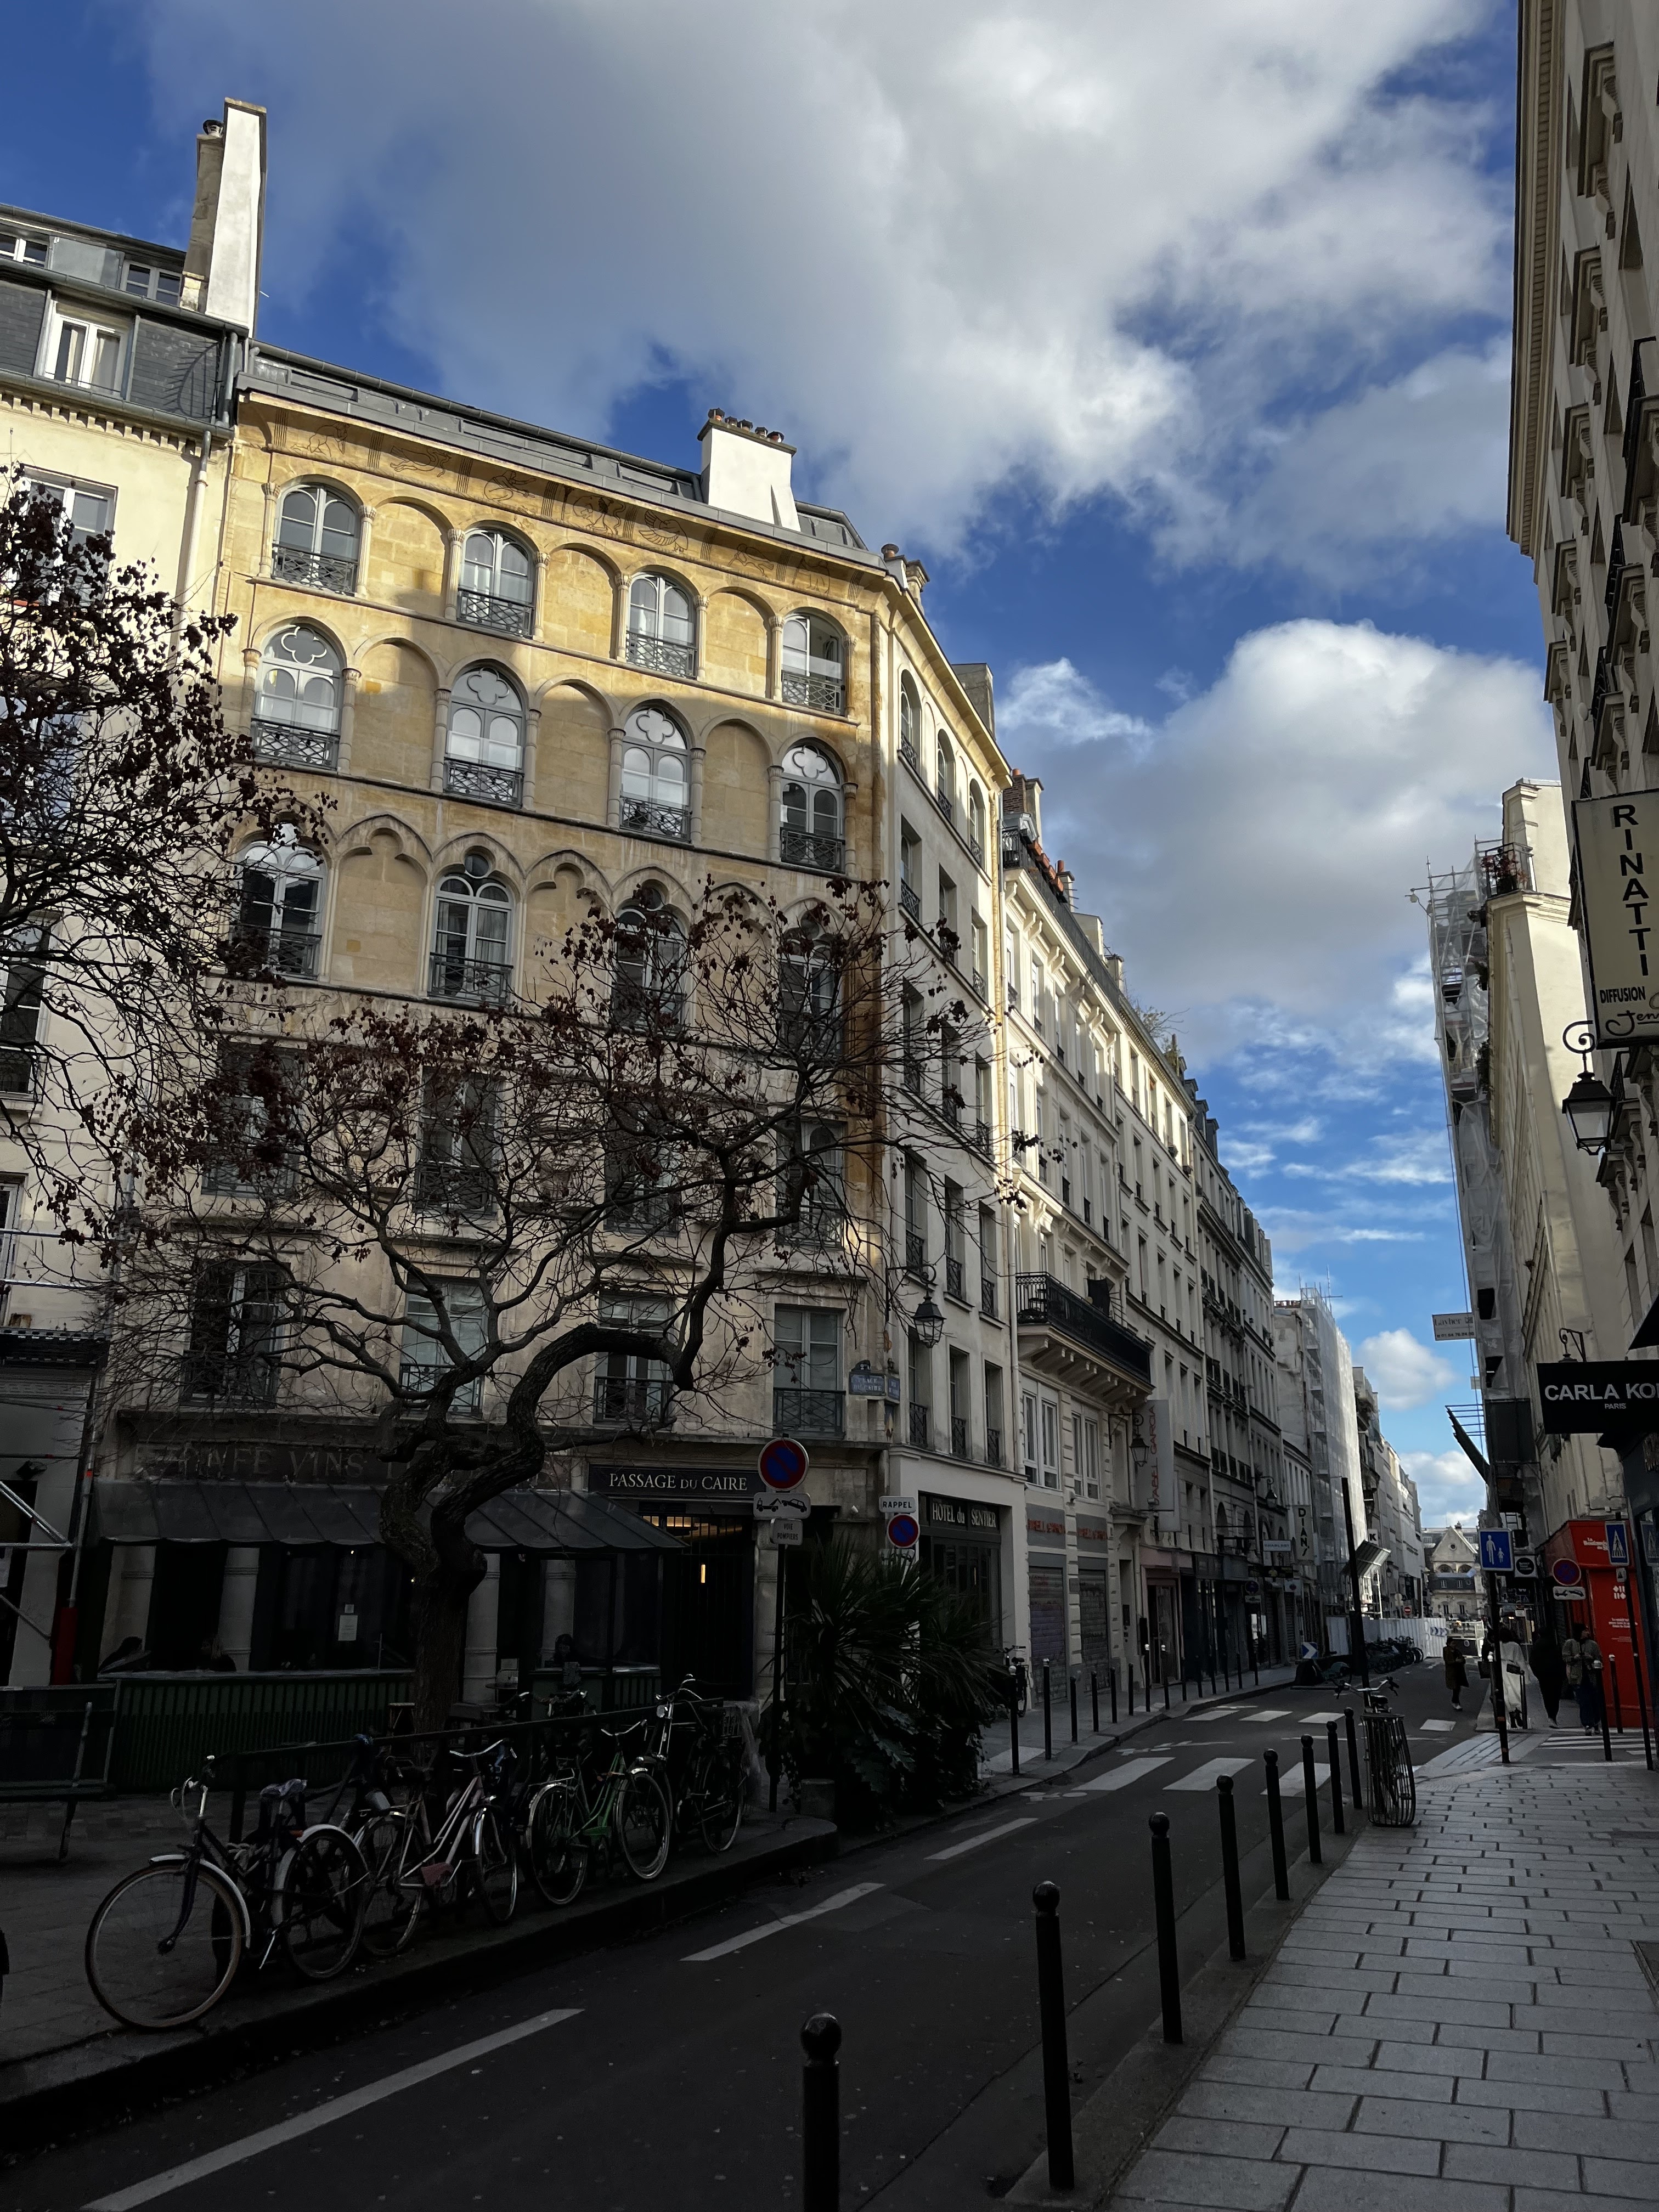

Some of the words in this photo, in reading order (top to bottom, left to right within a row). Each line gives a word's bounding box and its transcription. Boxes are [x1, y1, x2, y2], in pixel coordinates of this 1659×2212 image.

[1612, 804, 1651, 976] RINATTI
[1599, 986, 1646, 1004] DIFFUSION
[1544, 1384, 1621, 1401] CARLA
[1149, 1405, 1157, 1454] GARCIA
[289, 1451, 364, 1478] VINS
[610, 1473, 676, 1489] PASSAGE
[702, 1476, 748, 1491] CAIRE
[957, 1506, 965, 1524] du
[971, 1509, 996, 1528] SENTIER
[777, 1532, 799, 1541] POMPIERS
